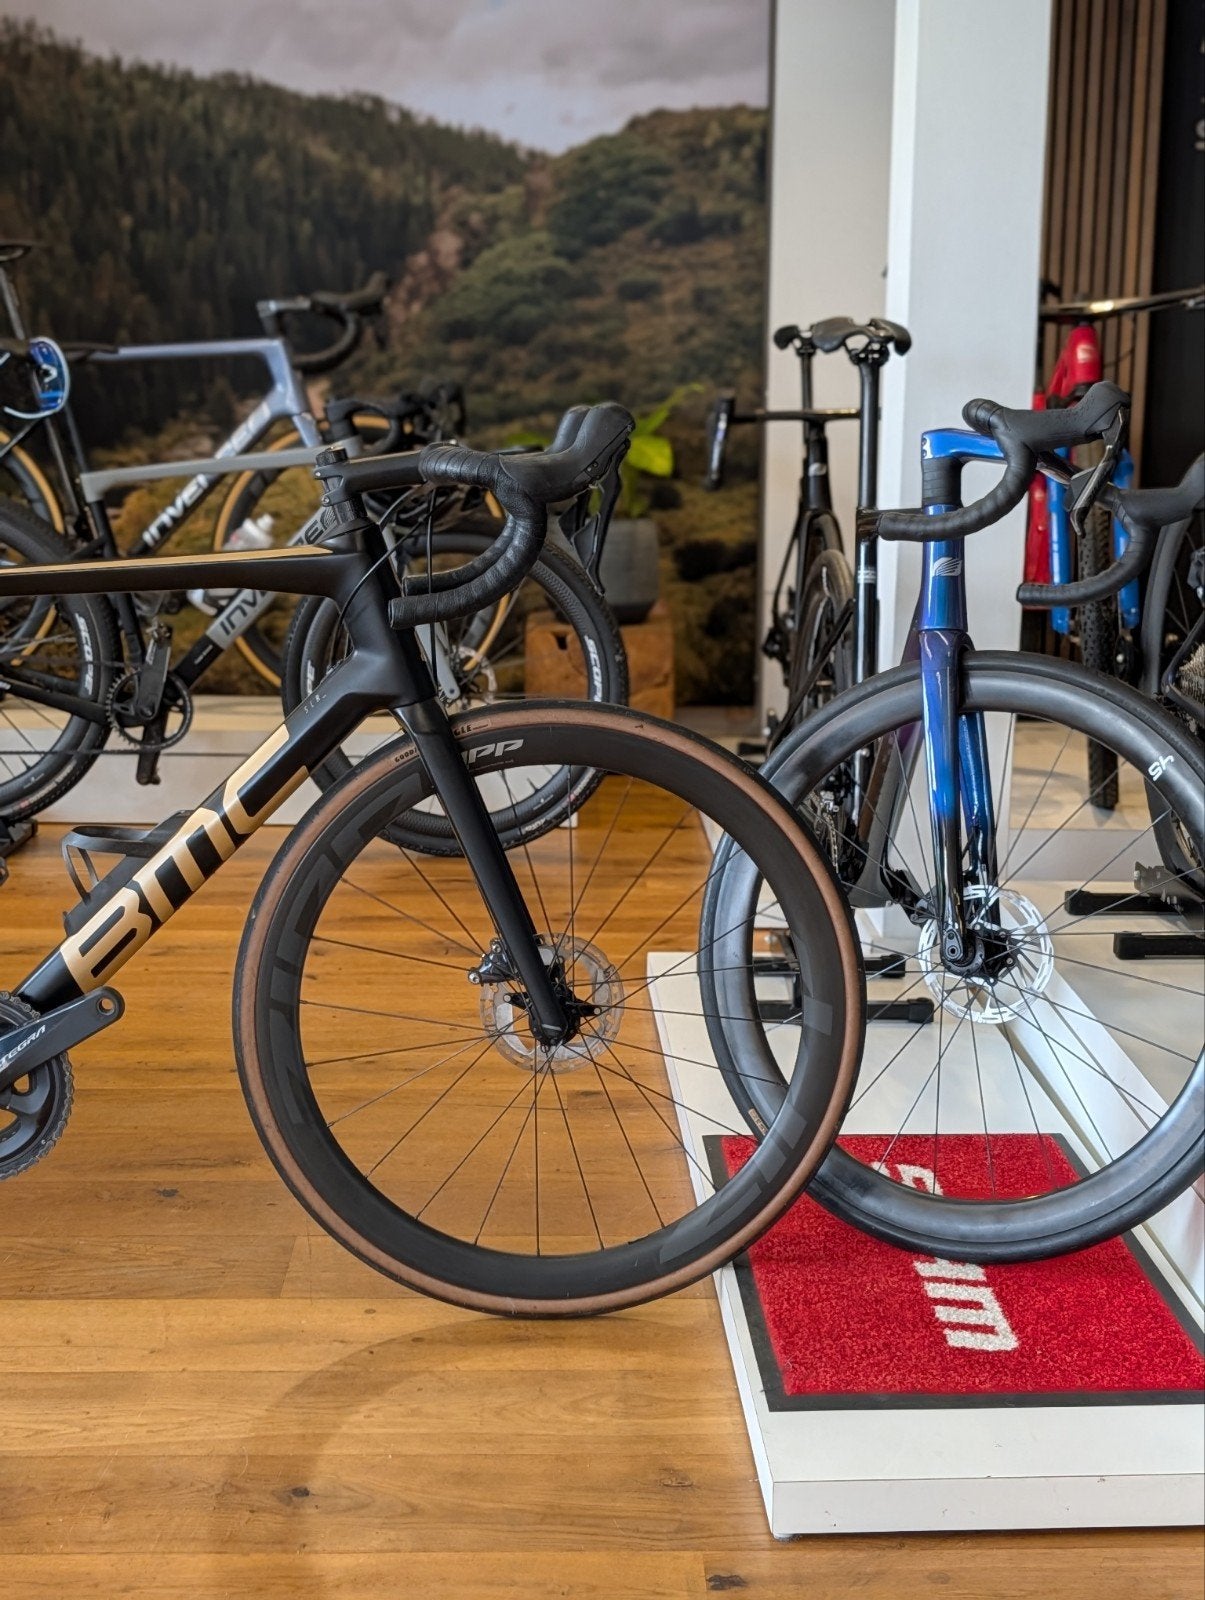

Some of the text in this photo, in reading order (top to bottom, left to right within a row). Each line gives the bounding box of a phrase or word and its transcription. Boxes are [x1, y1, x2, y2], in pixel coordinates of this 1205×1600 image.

[394, 746, 418, 763] GOOD
[60, 723, 310, 994] BMC
[0, 1024, 46, 1068] TEGRA
